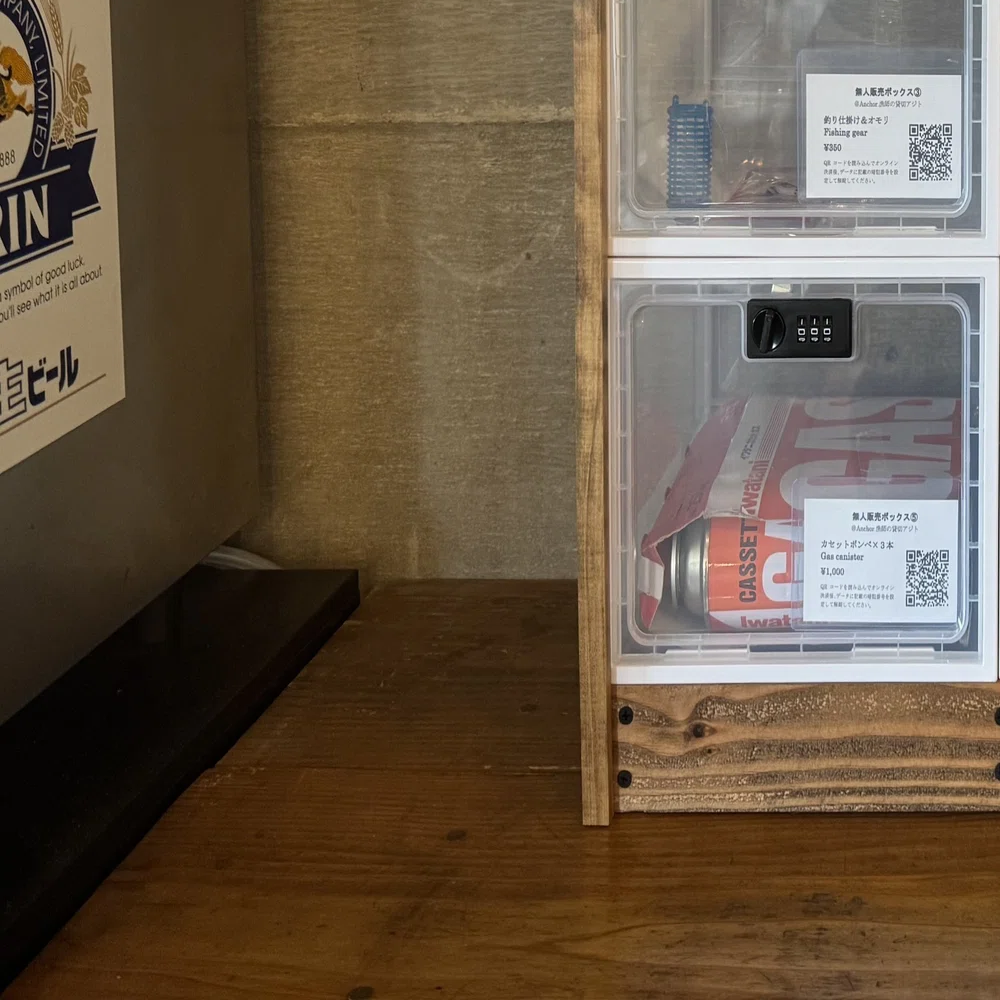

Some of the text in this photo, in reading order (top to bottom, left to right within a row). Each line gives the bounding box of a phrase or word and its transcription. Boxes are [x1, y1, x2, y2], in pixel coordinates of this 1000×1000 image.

[855, 87, 922, 97] 無人販売ボックス③
[32, 54, 50, 158] LIMITED
[824, 128, 868, 138] Fishing gear
[824, 143, 842, 152] ¥350
[4, 275, 33, 301] symbol
[35, 271, 43, 286] of
[45, 263, 66, 284] good
[17, 300, 31, 315] see
[33, 287, 53, 307] what
[55, 284, 60, 297] it
[62, 282, 67, 294] is
[69, 276, 78, 290] all
[80, 265, 103, 285] about
[852, 512, 918, 523] 無人販売ボックス⑤
[820, 552, 864, 561] Gas canister
[820, 567, 845, 576] ¥1,000
